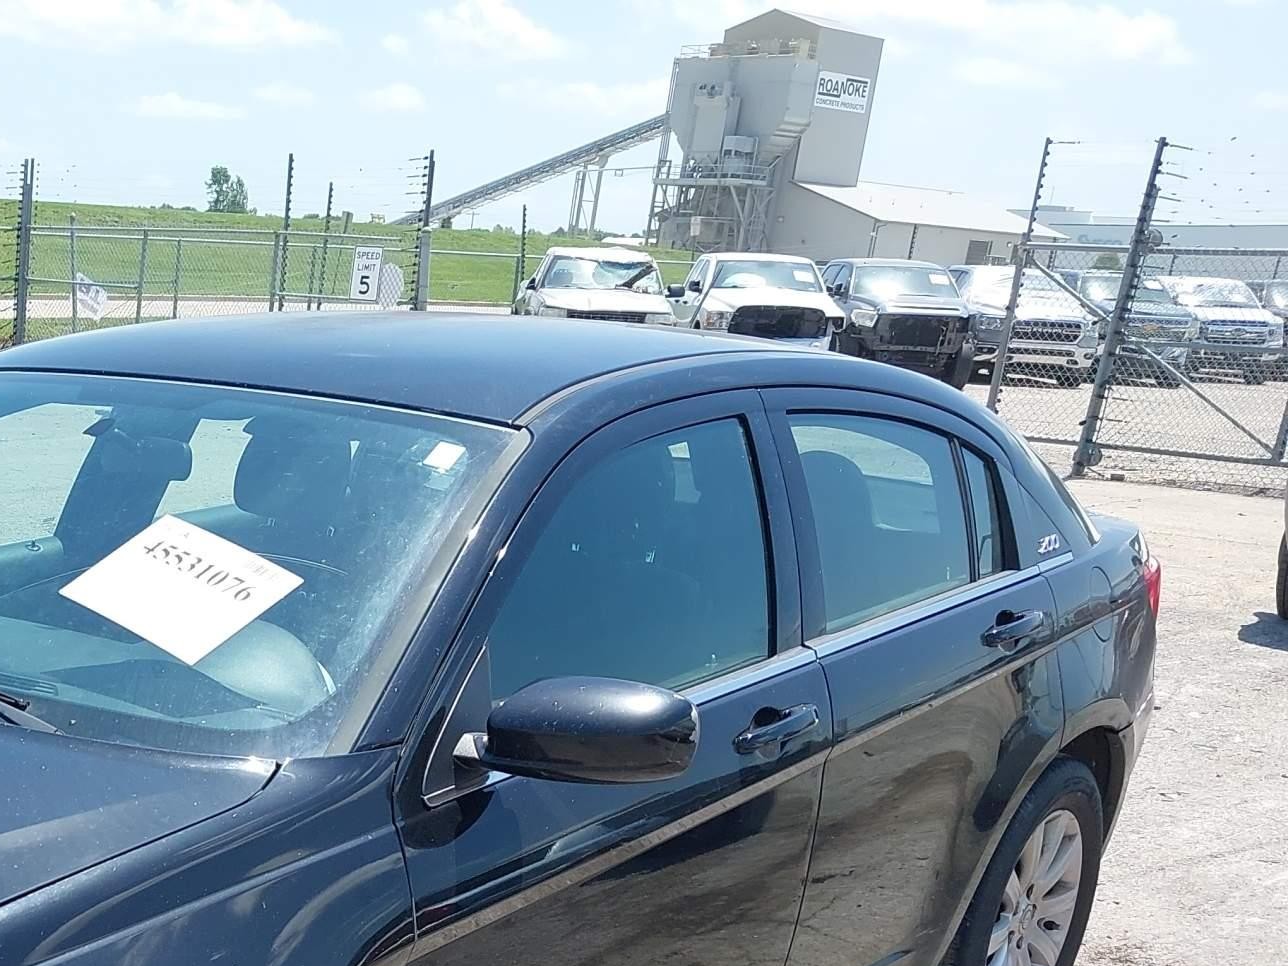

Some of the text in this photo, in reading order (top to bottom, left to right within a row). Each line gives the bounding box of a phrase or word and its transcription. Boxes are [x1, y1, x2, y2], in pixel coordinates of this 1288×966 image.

[818, 77, 868, 98] ROANOKE
[815, 97, 865, 111] CONCRETE PRODUCTS
[356, 251, 381, 260] SPEED
[357, 263, 376, 272] LIMIT
[358, 275, 370, 295] 5
[143, 540, 257, 601] 45531076
